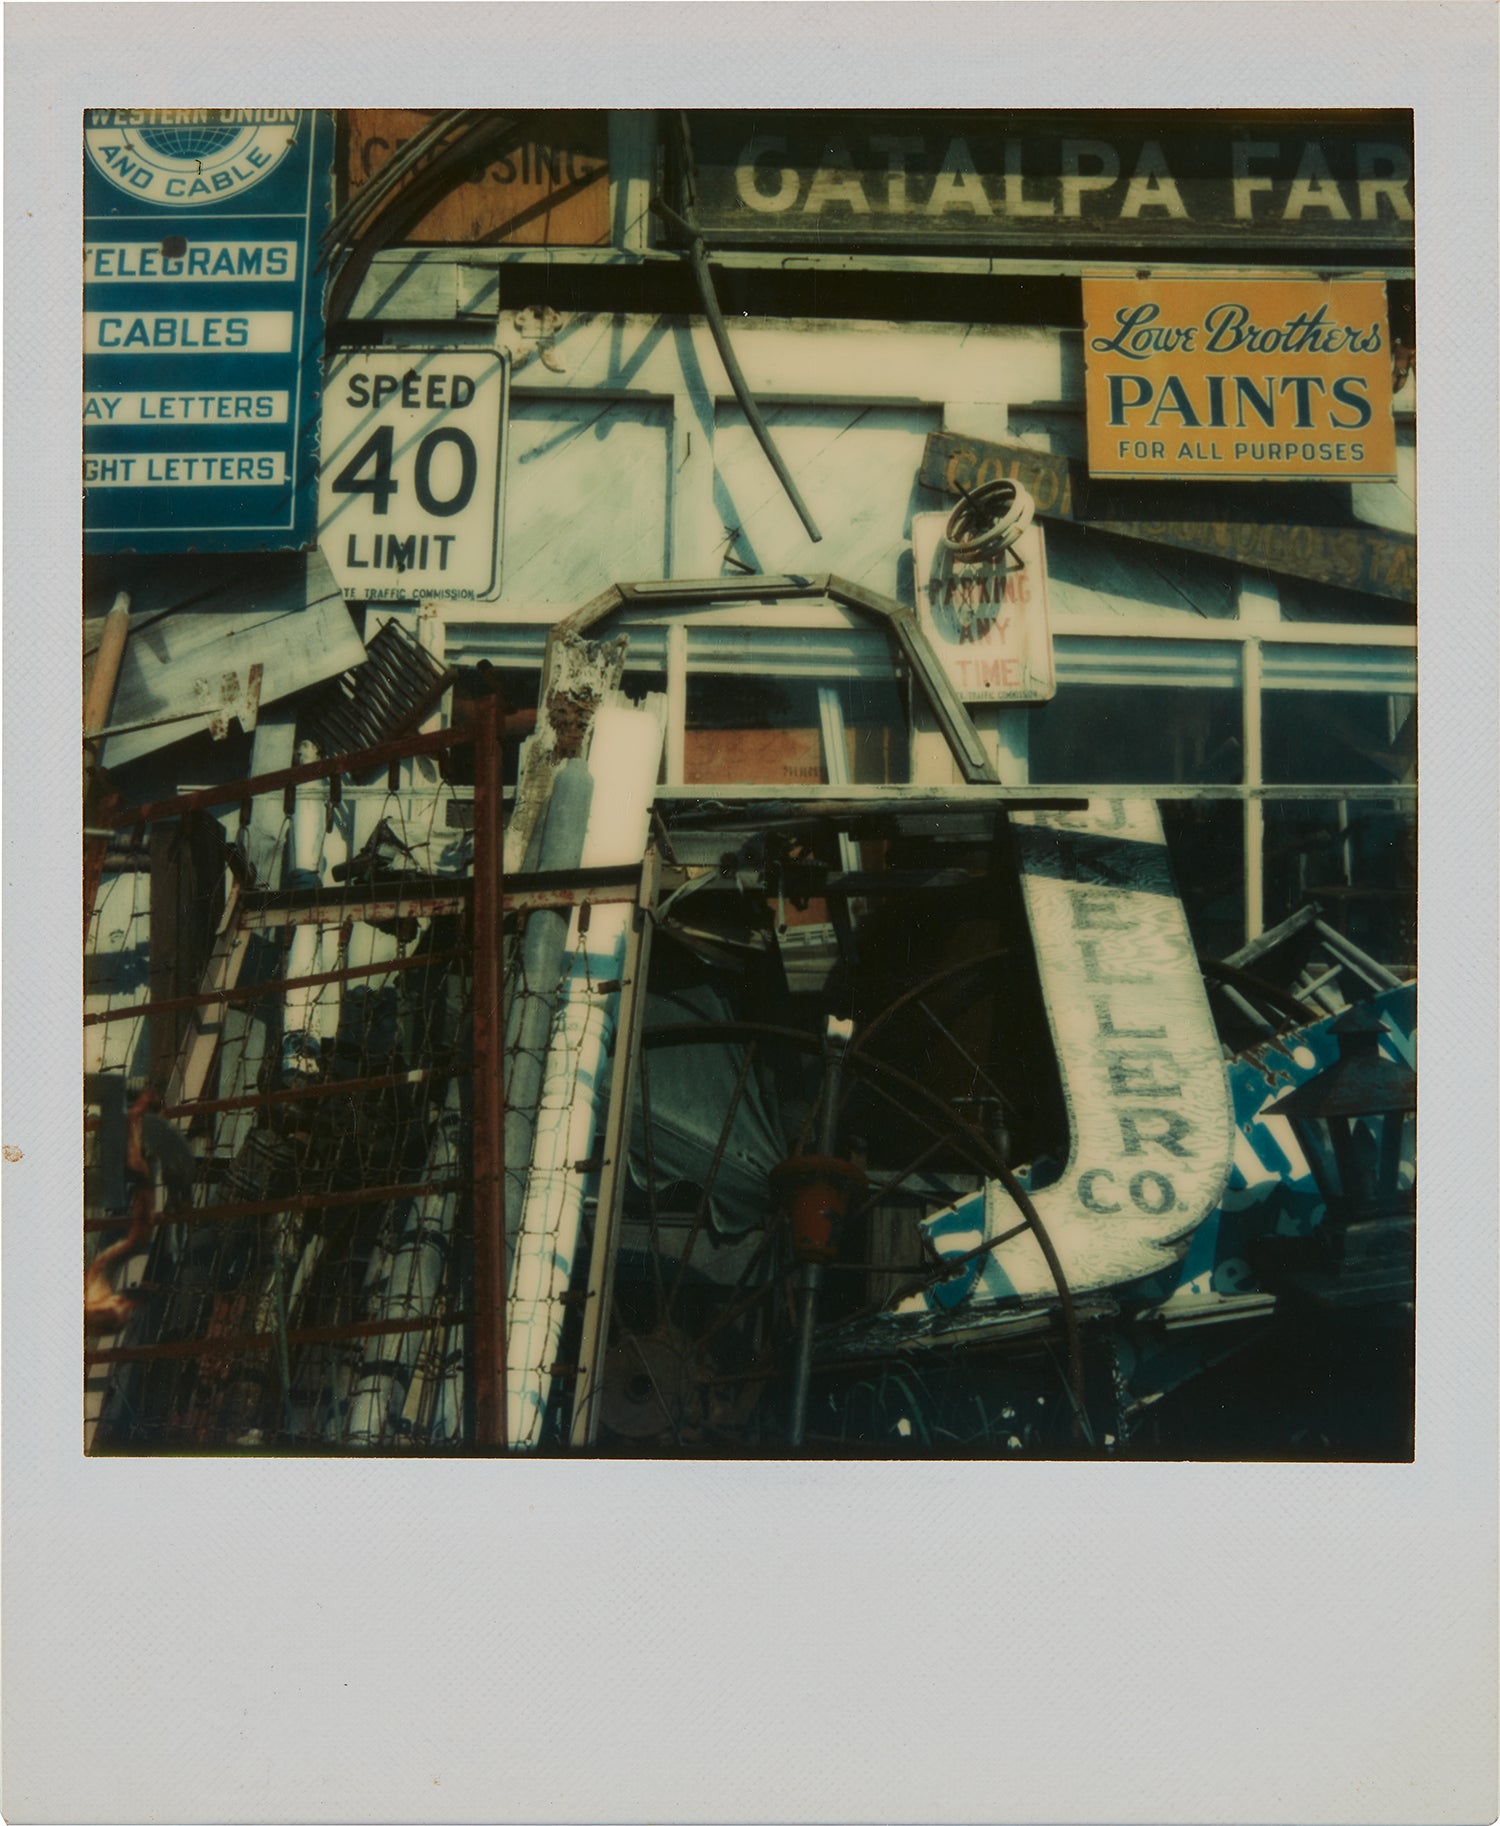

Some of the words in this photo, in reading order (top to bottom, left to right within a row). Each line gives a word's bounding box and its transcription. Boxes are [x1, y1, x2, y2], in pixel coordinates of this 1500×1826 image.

[98, 146, 154, 190] AND
[165, 147, 272, 198] CABLE
[1230, 140, 1414, 221] FAR
[86, 246, 289, 277] ELEGRAMS
[98, 317, 250, 348] CABLES
[1091, 302, 1198, 361] Lowe
[1203, 302, 1383, 354] Brothers
[140, 396, 274, 419] LETTERS
[346, 372, 477, 410] SPEED
[1104, 373, 1373, 430] PAINTS
[1118, 440, 1166, 460] FOR
[1177, 442, 1224, 461] ALL
[1234, 442, 1365, 462] PURPOSES
[147, 457, 275, 481] LETTERS
[331, 424, 478, 518] 40
[346, 533, 457, 571] LIMIT
[364, 588, 406, 601] TRAFFIC
[411, 588, 474, 601] COMMISSION
[958, 617, 1011, 646] ANY
[955, 658, 1021, 688] TIME
[1057, 838, 1201, 1158] KELLER
